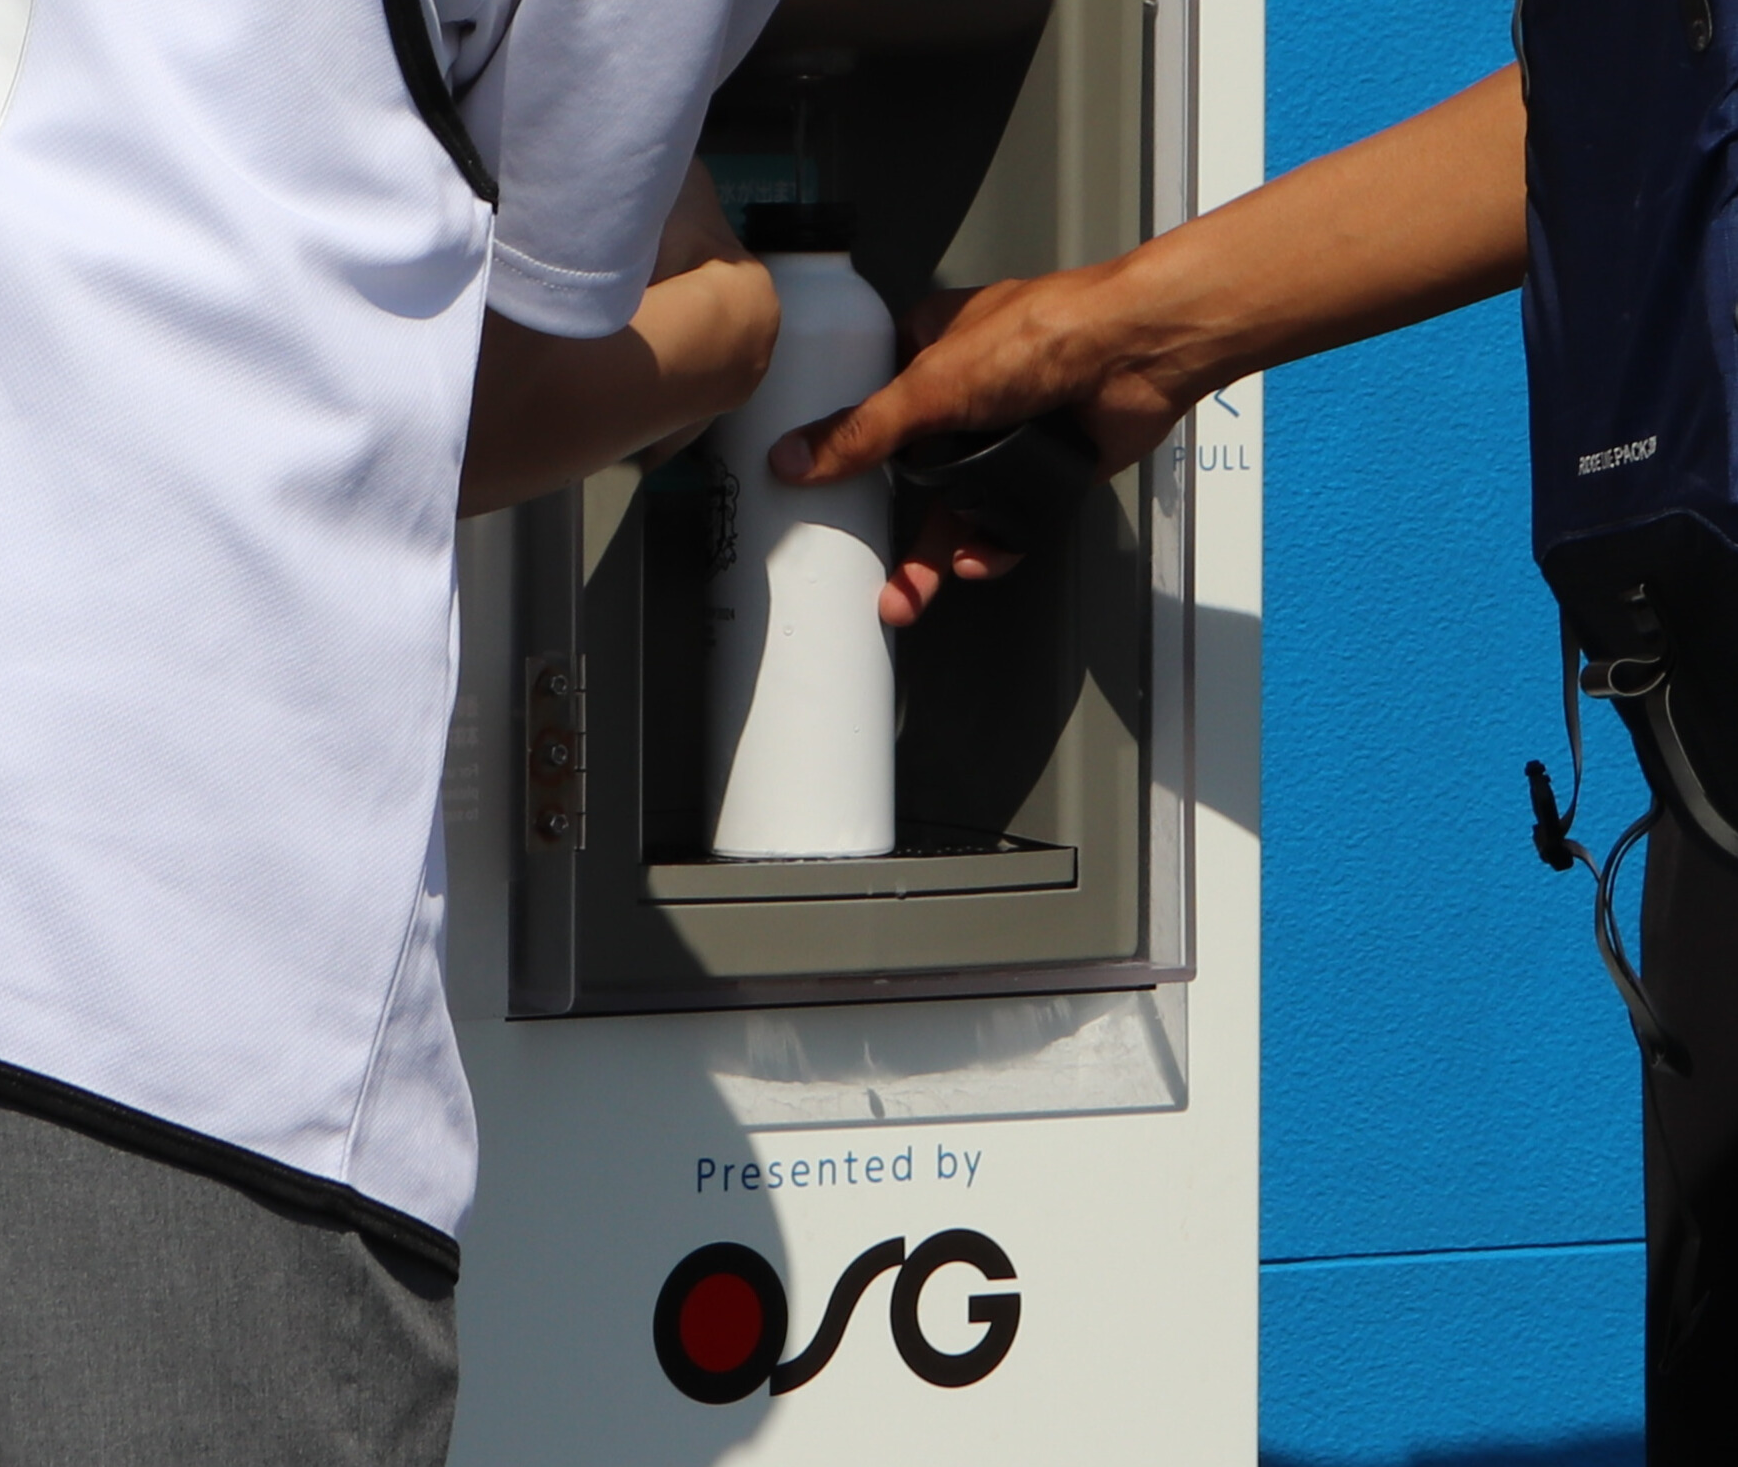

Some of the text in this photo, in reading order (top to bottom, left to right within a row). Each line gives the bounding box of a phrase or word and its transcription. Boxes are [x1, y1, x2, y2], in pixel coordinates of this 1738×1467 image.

[1172, 444, 1252, 472] PULL
[696, 1143, 982, 1194] Presented by
